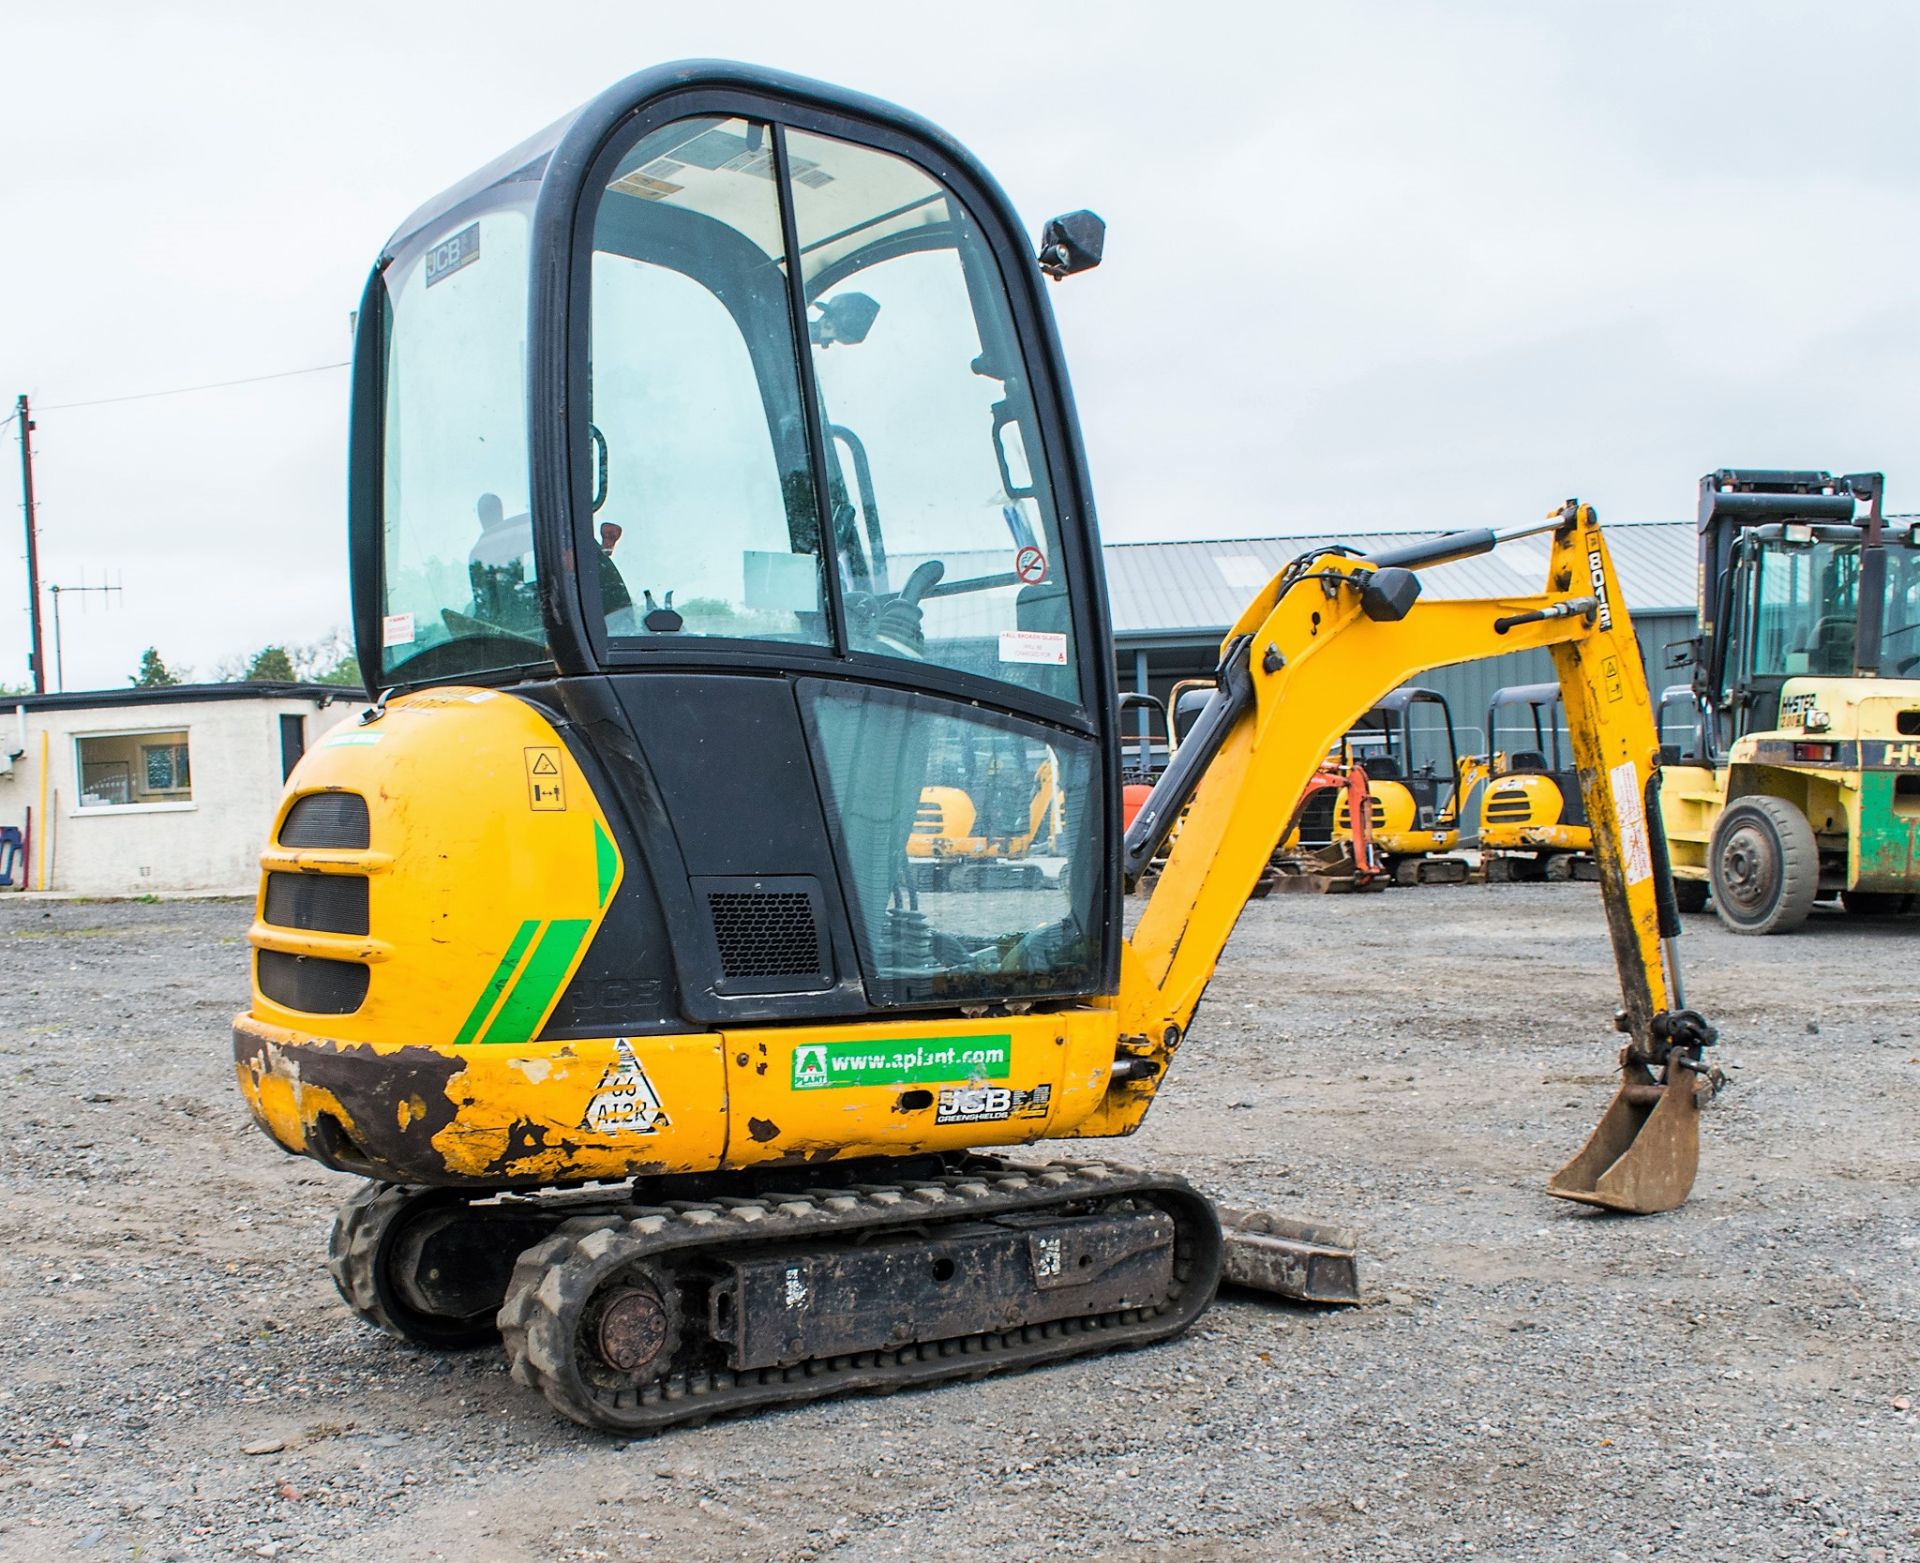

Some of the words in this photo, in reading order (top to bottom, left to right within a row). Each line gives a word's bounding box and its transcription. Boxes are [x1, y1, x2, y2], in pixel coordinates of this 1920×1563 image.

[426, 238, 461, 278] JCB
[1781, 693, 1816, 713] HYSTER
[831, 1047, 1004, 1073] www.aplant.com
[938, 1088, 1012, 1116] JCB
[937, 1111, 1009, 1123] GREENSHIELDS
